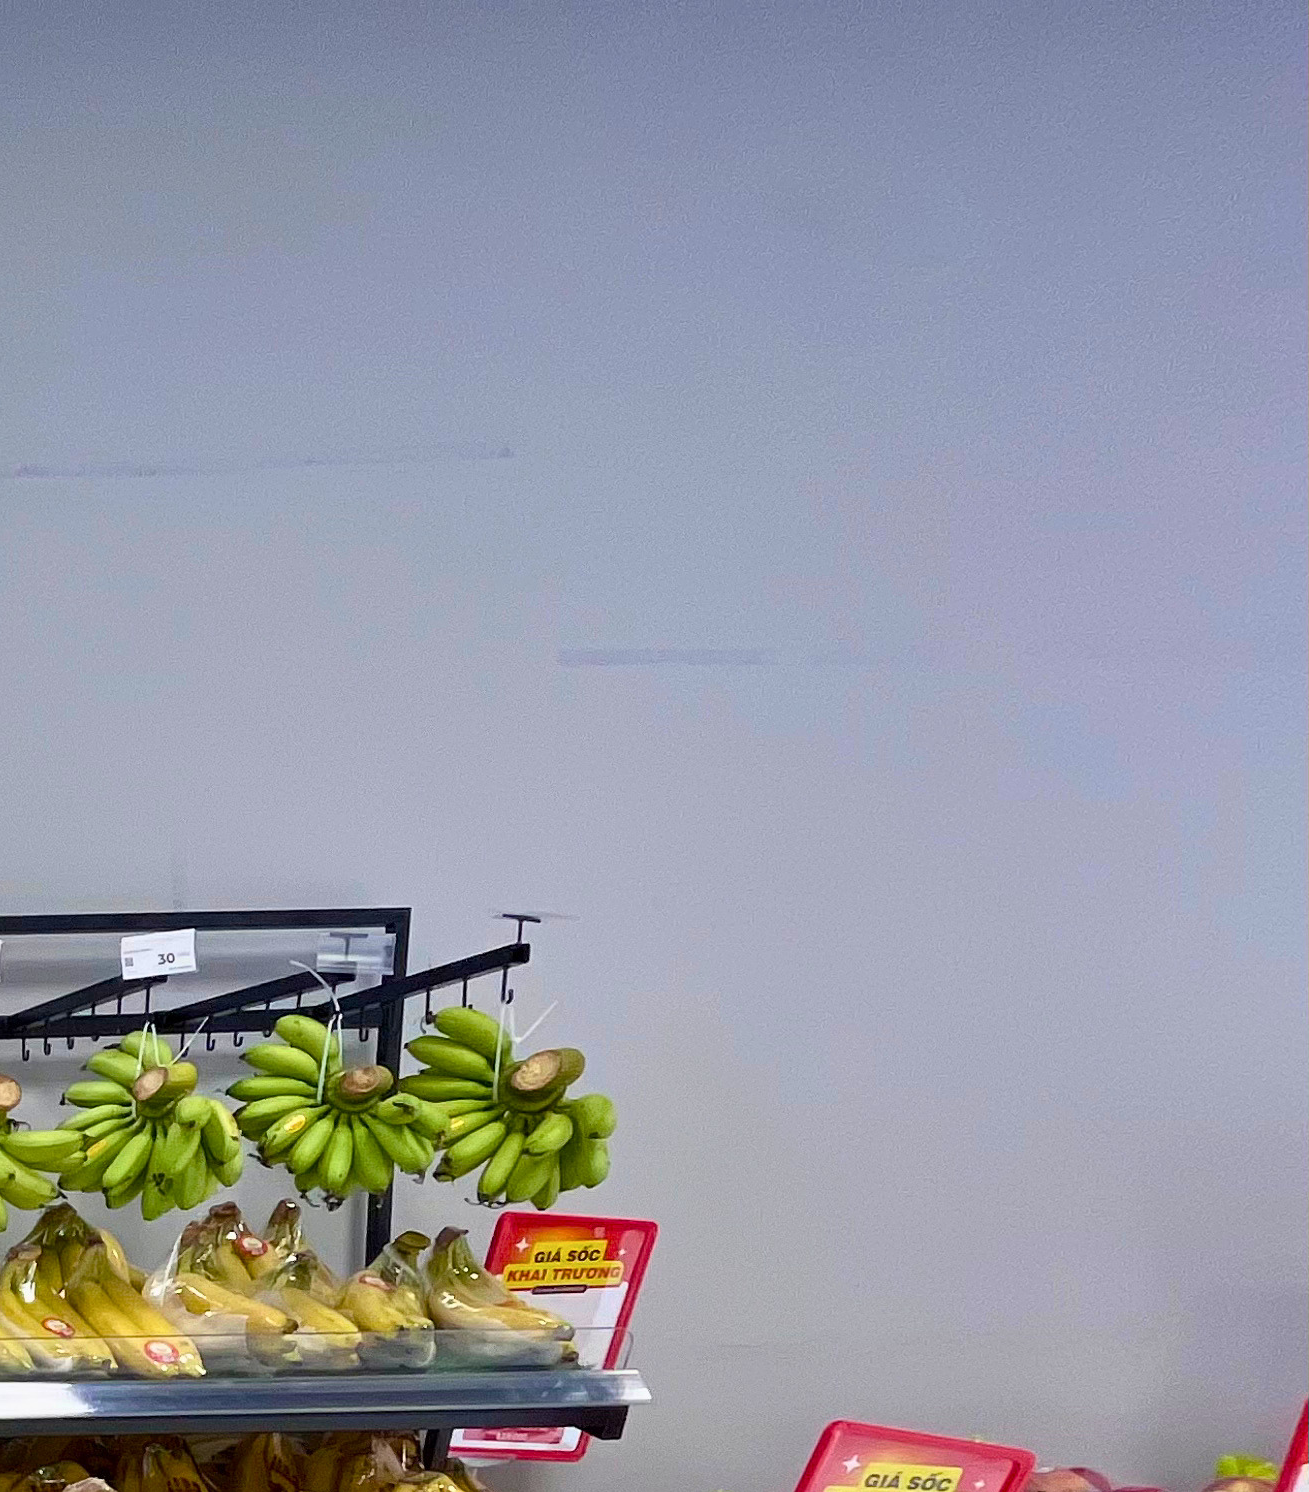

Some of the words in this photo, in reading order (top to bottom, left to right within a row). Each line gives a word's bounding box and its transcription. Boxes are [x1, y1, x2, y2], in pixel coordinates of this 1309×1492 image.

[157, 953, 176, 965] 30
[534, 1247, 562, 1263] GIÁ
[567, 1245, 601, 1262] SỐC
[507, 1268, 547, 1282] KHAI
[864, 1472, 901, 1489] GIÁ
[907, 1472, 952, 1492] SỐC
